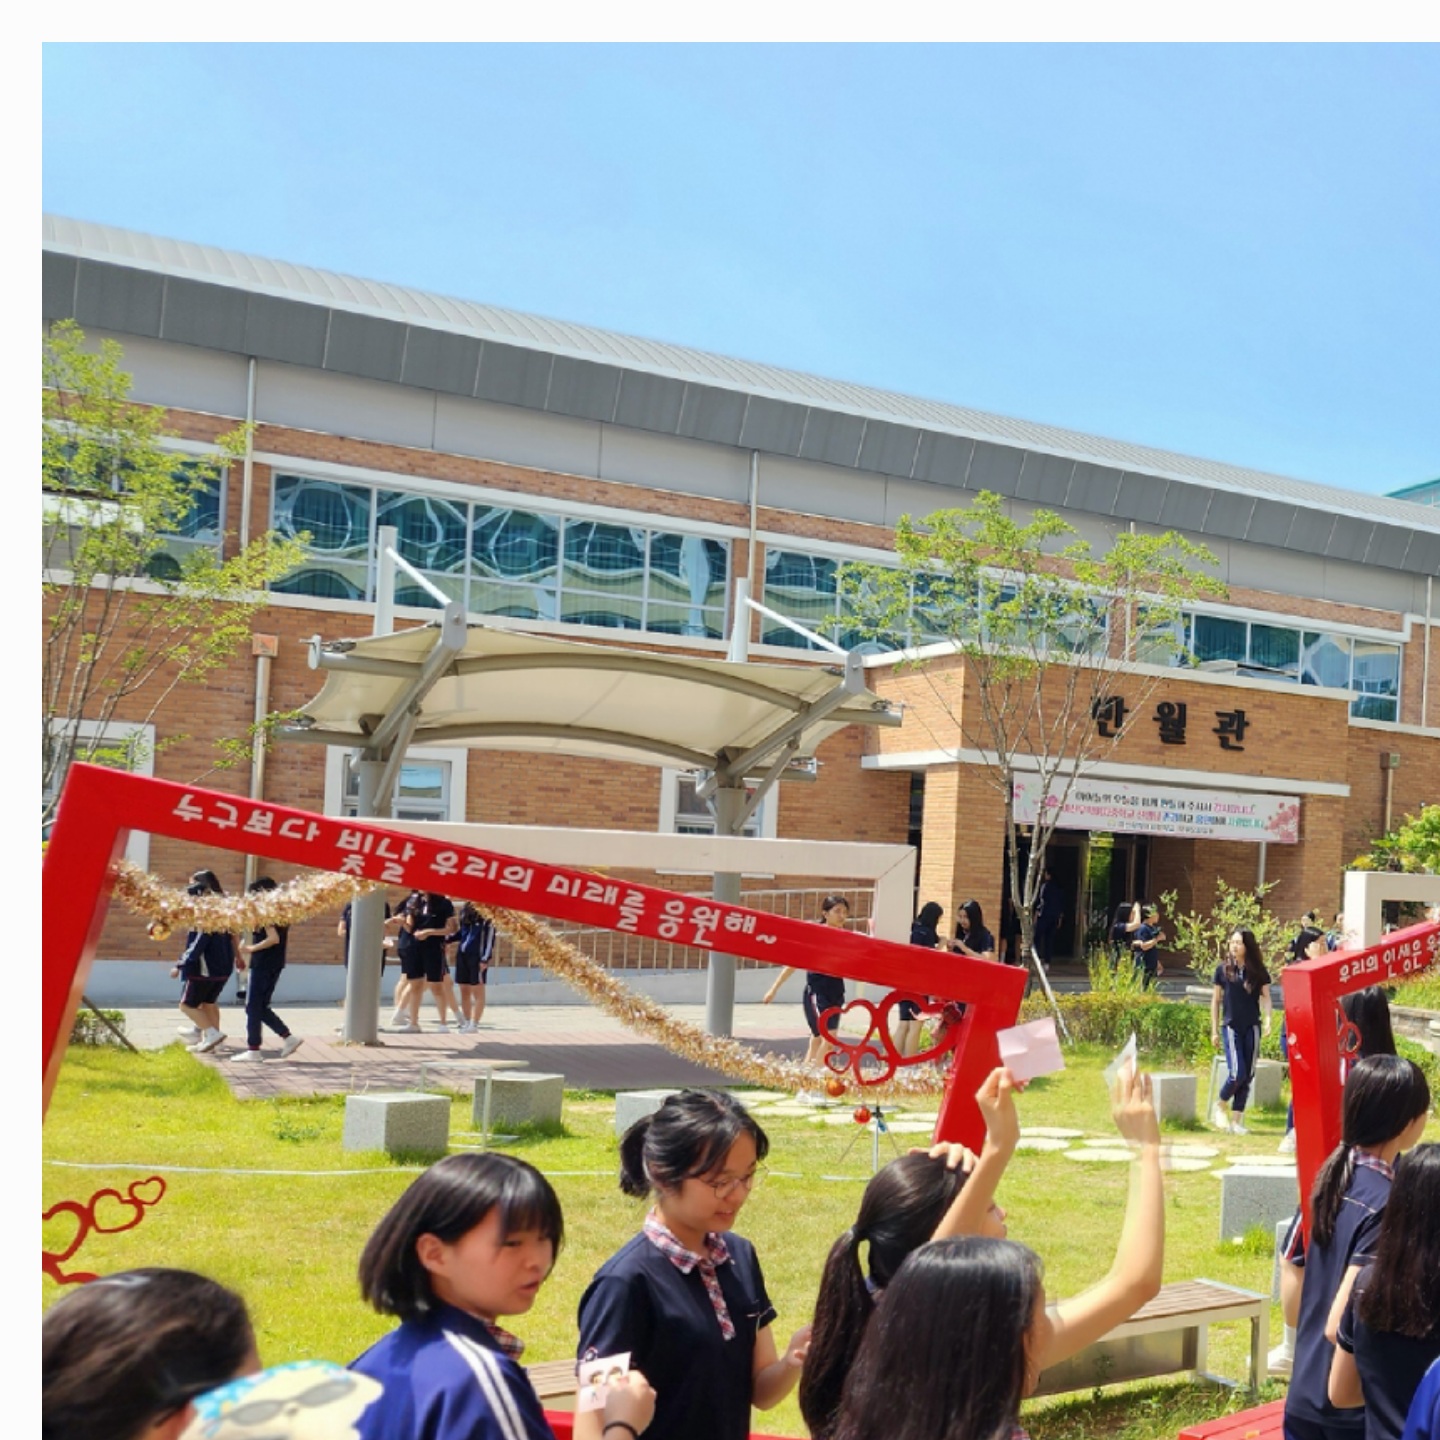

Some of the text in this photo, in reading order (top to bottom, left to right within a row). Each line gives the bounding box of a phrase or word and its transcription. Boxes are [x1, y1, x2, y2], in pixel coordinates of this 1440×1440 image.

[1090, 695, 1250, 751] 반월관
[172, 794, 777, 947] 누구보다 빛날 우리의 미래를 응원해~
[1339, 955, 1378, 983] 우리의
[1383, 940, 1422, 978] 인생은
